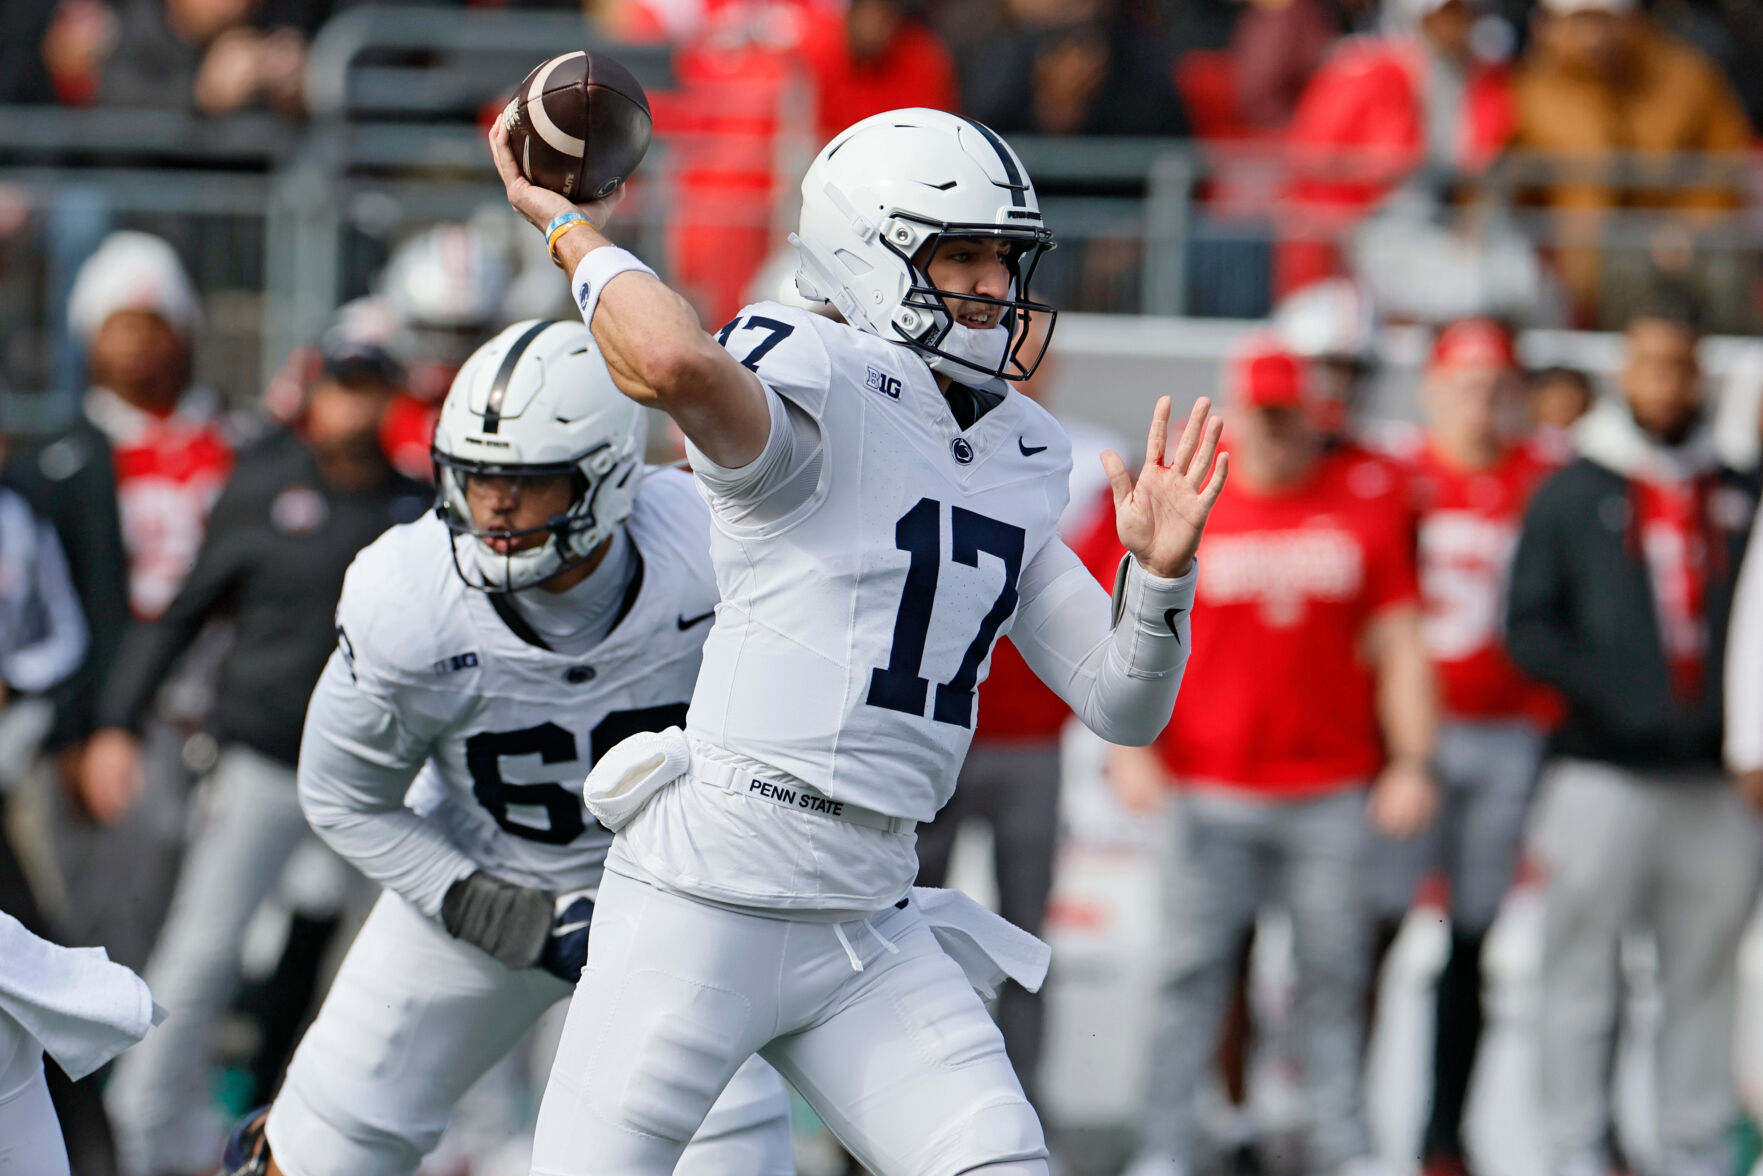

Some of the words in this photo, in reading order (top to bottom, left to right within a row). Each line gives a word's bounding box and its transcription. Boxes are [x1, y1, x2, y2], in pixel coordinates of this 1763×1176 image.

[865, 497, 1026, 729] 17
[749, 778, 796, 804] PENN
[798, 794, 844, 816] STATE
